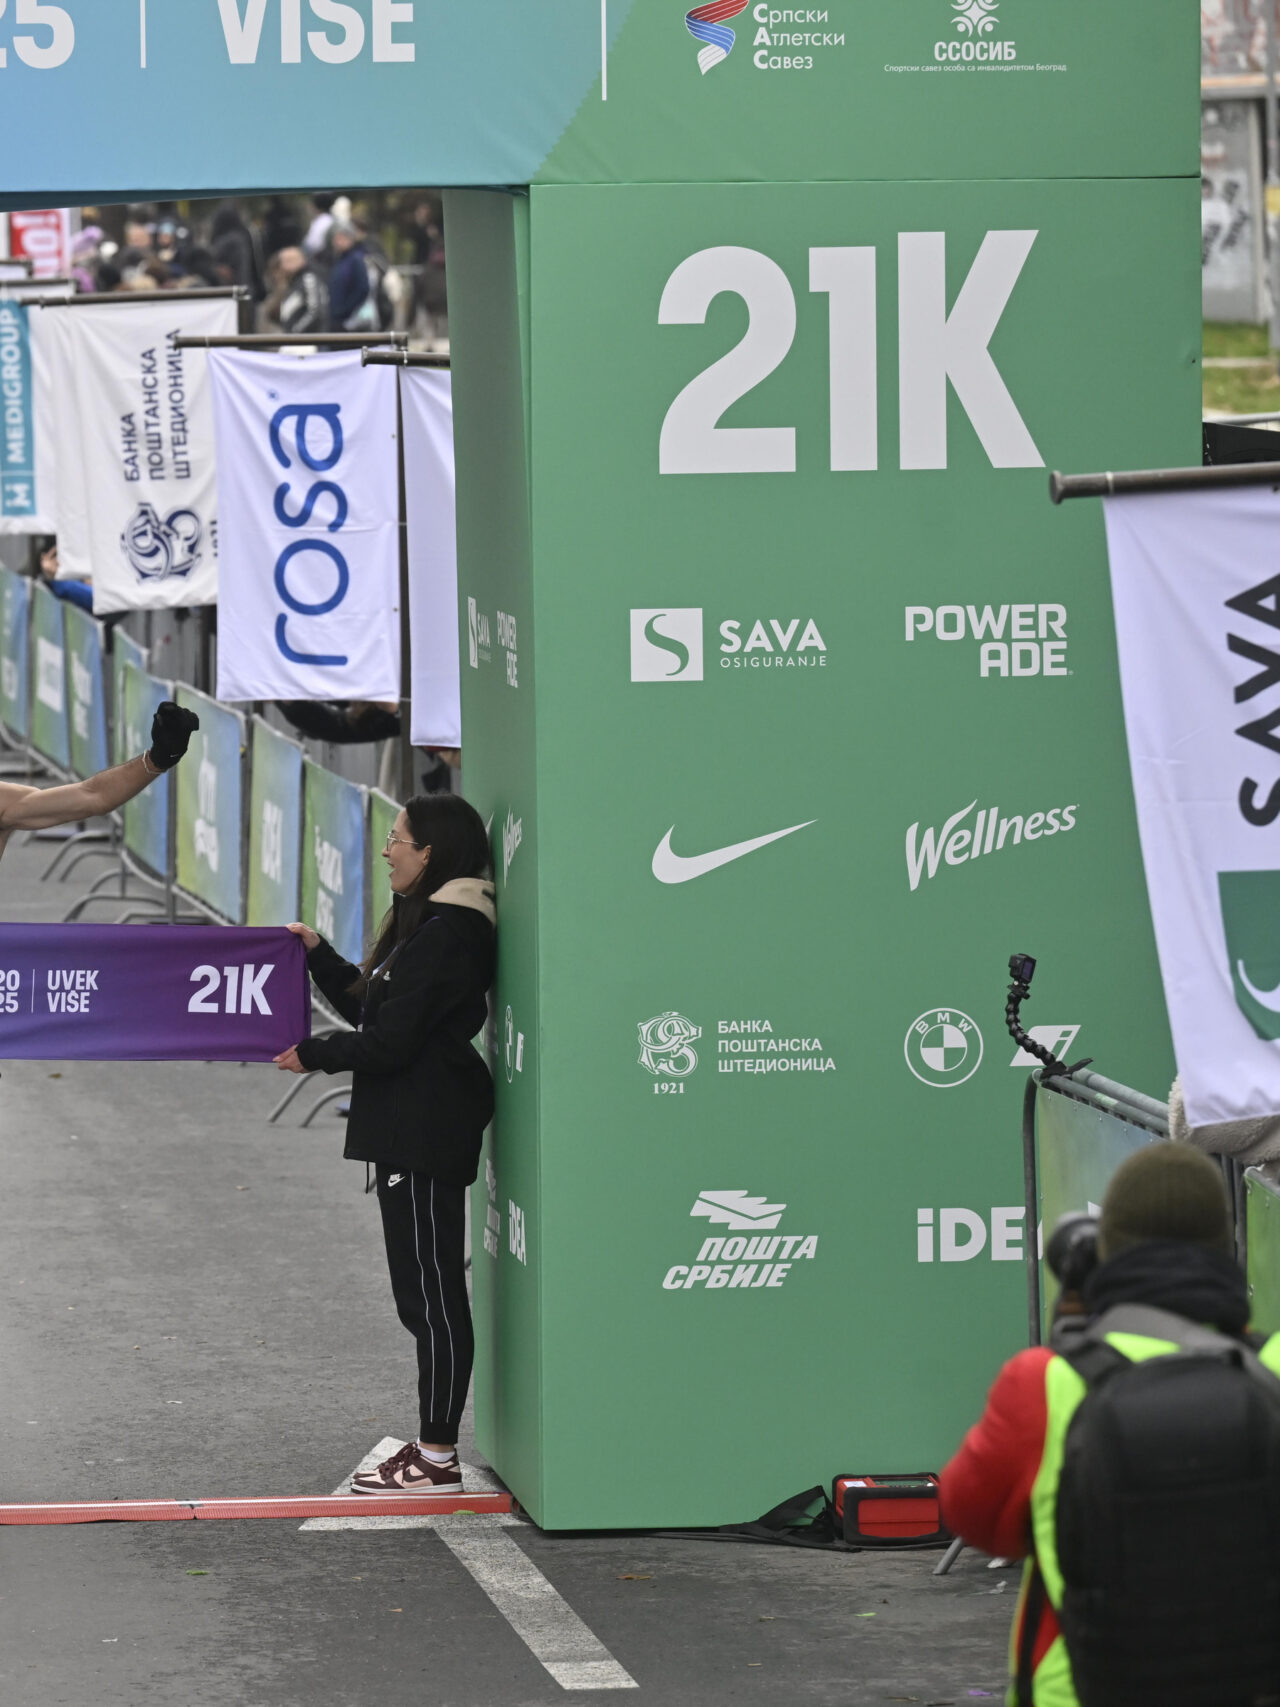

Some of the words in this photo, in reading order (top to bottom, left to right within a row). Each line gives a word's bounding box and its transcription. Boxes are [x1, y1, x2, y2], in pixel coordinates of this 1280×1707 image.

[752, 3, 829, 29] Српски
[752, 26, 846, 47] Атлетски
[752, 49, 814, 70] Савез
[933, 40, 1017, 62] ССОСИБ
[884, 64, 920, 73] Спортски
[943, 63, 966, 72] особа
[1036, 63, 1067, 73] Београд
[657, 229, 1047, 475] 21K
[140, 347, 165, 481] ПОШТАНСКА
[121, 412, 141, 482] БАНКА
[269, 403, 350, 666] rosa
[905, 603, 1068, 641] POWER
[719, 618, 827, 654] SAVA
[720, 655, 827, 668] OSIGURANJE
[980, 641, 1068, 677] ADE
[905, 799, 1078, 892] Wellness
[46, 969, 100, 991] UVEK
[187, 963, 276, 1016] 21K
[46, 989, 91, 1013] VIŠE
[717, 1019, 773, 1034] БАНКА
[718, 1038, 823, 1053] ПОШТАНСКА
[718, 1057, 837, 1074] ШТЕДИОНИЦА
[653, 1082, 685, 1095] 1921
[917, 1206, 1043, 1263] iDE
[695, 1235, 819, 1262] ПОШТА
[662, 1263, 793, 1290] СРБИЈЕ
